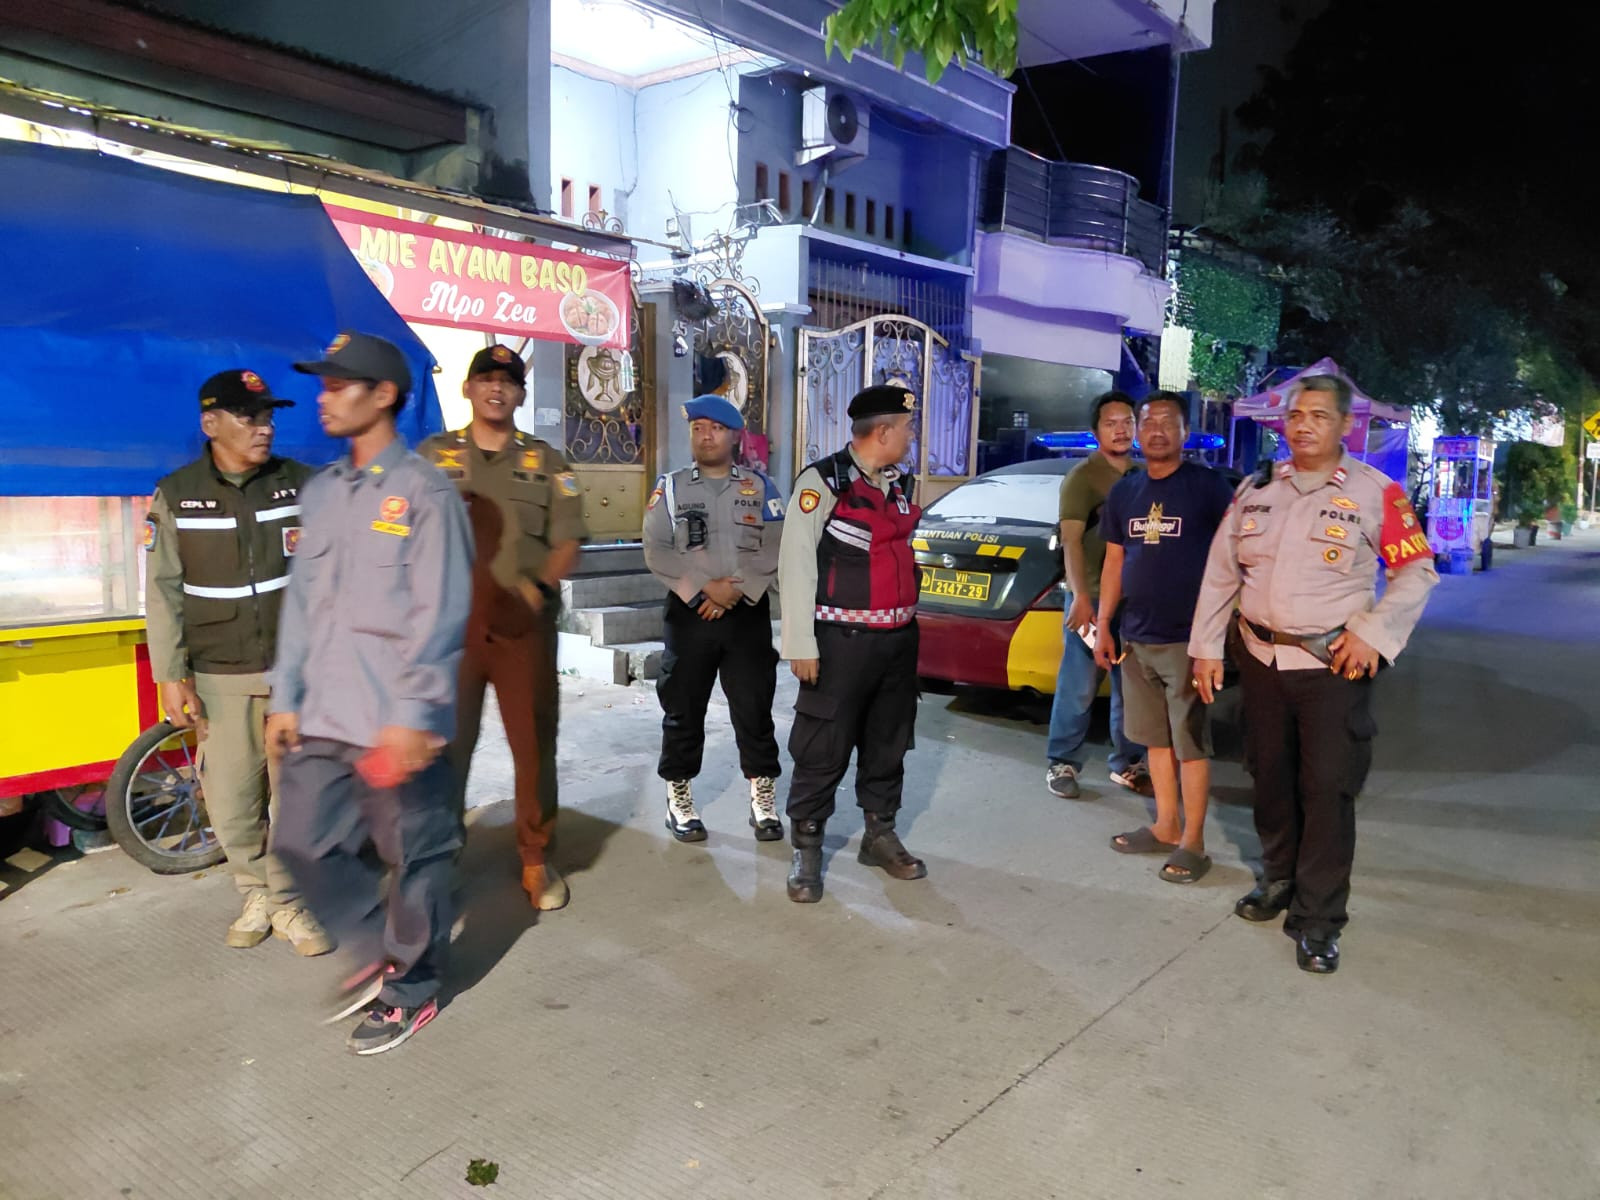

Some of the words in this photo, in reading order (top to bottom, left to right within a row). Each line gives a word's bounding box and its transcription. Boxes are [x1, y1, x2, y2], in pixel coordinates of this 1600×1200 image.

[358, 225, 417, 270] MIE
[428, 238, 511, 286] AYAM
[520, 255, 588, 297] BASO
[421, 280, 485, 322] Mpo
[492, 291, 536, 325] Zea
[677, 502, 706, 511] AGUNG
[734, 499, 761, 507] POLRI
[1319, 509, 1361, 525] POLRI
[963, 531, 1000, 544] POLISI
